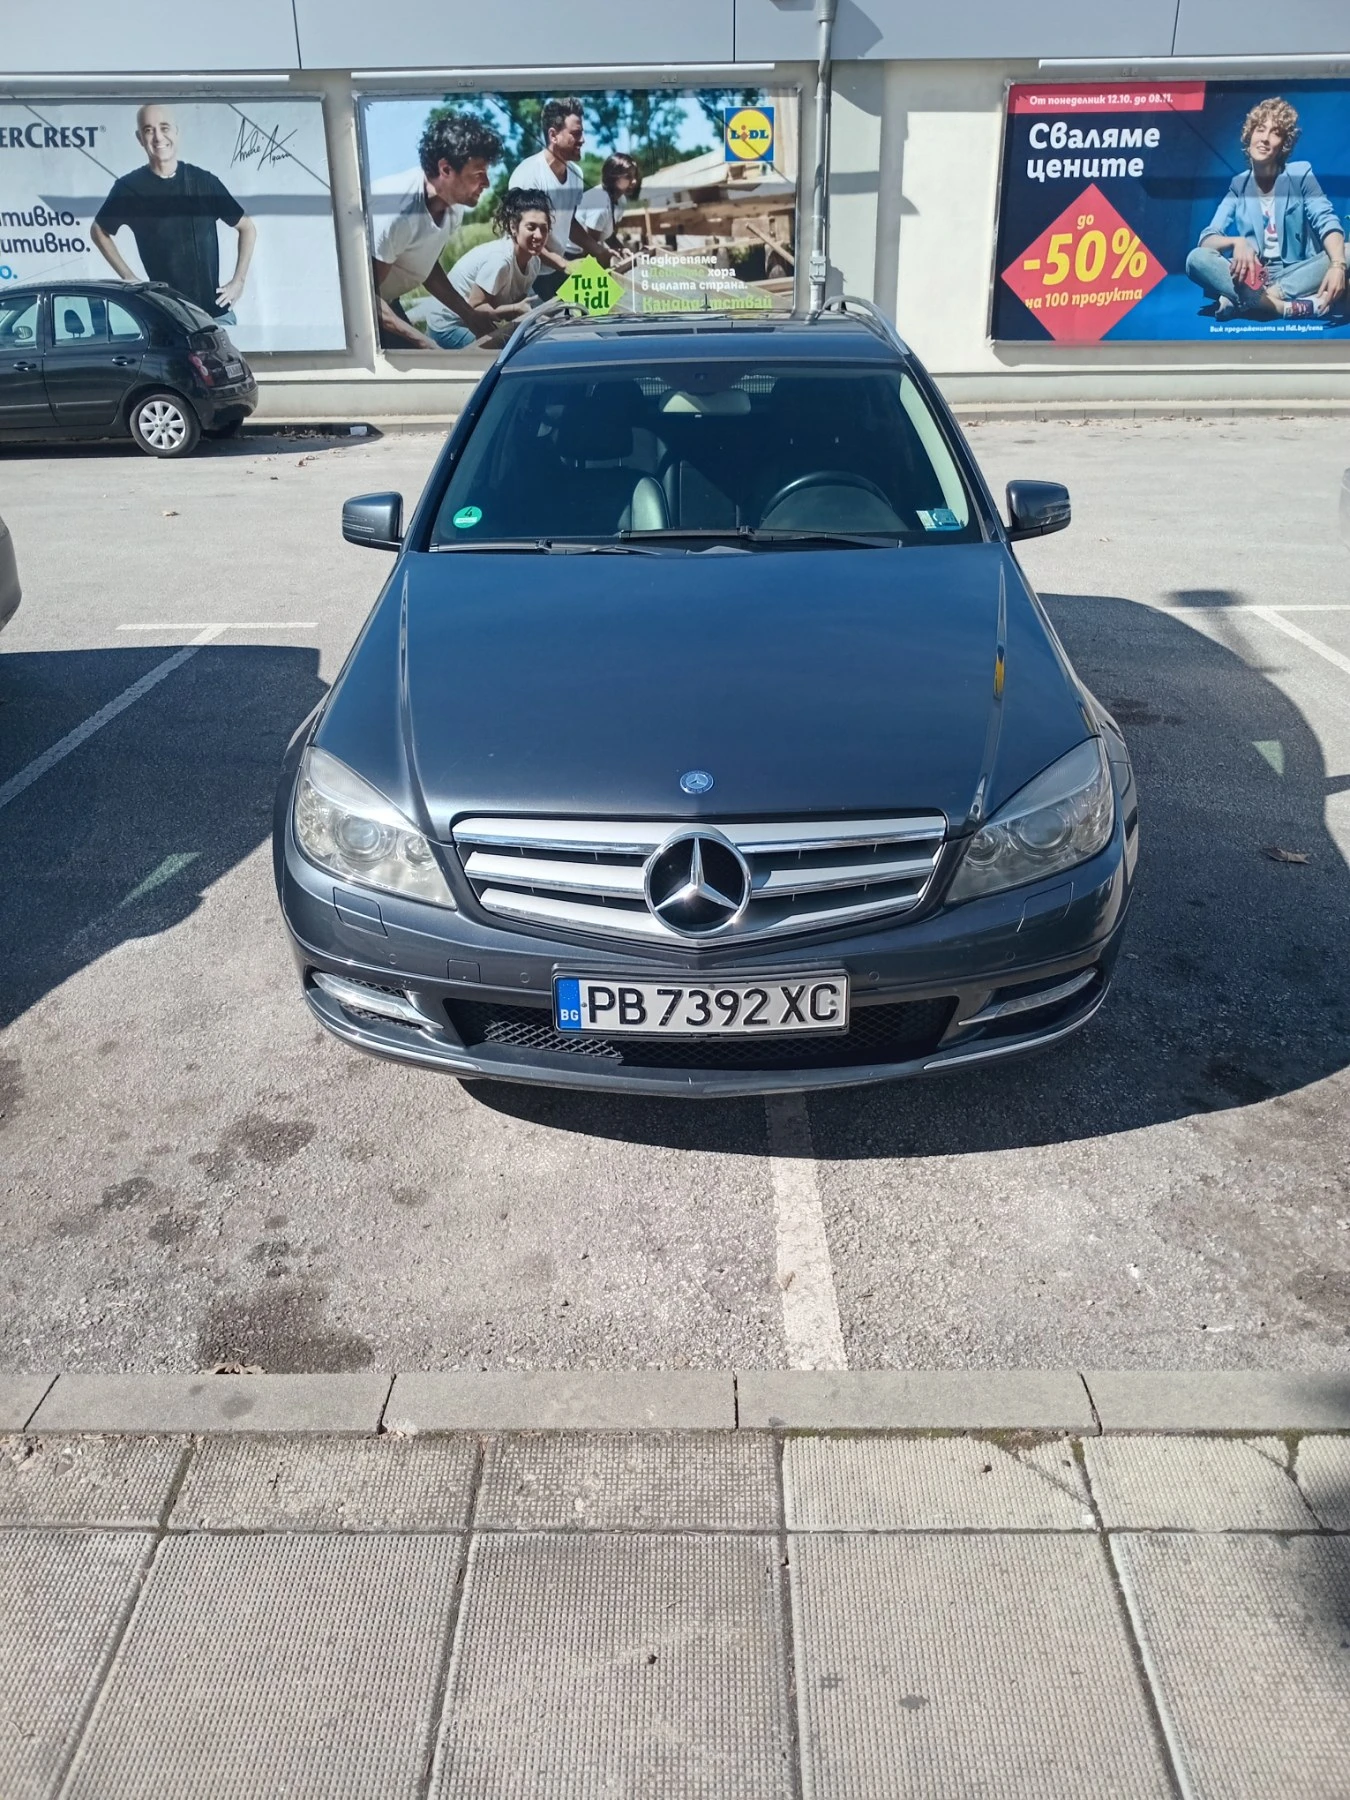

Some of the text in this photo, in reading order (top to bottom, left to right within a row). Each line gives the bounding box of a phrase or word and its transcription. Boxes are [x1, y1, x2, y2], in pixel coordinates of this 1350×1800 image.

[1029, 95, 1046, 105] От
[1048, 95, 1105, 107] понеделник
[1107, 94, 1132, 104] 12.10.
[1134, 95, 1147, 106] до
[1029, 121, 1161, 150] Сваляме
[1026, 156, 1145, 183] цените
[0, 205, 81, 227] тивно.
[1077, 214, 1094, 230] до
[641, 254, 718, 266] Подкрепяме
[1023, 227, 1148, 286] -50%
[571, 274, 609, 290] Ти и
[641, 270, 649, 278] и
[707, 267, 736, 279] хора
[641, 280, 748, 292] в цялата страна.
[1025, 287, 1143, 309] на 100 продукта
[560, 983, 838, 1027] BG PB 7392 XC
